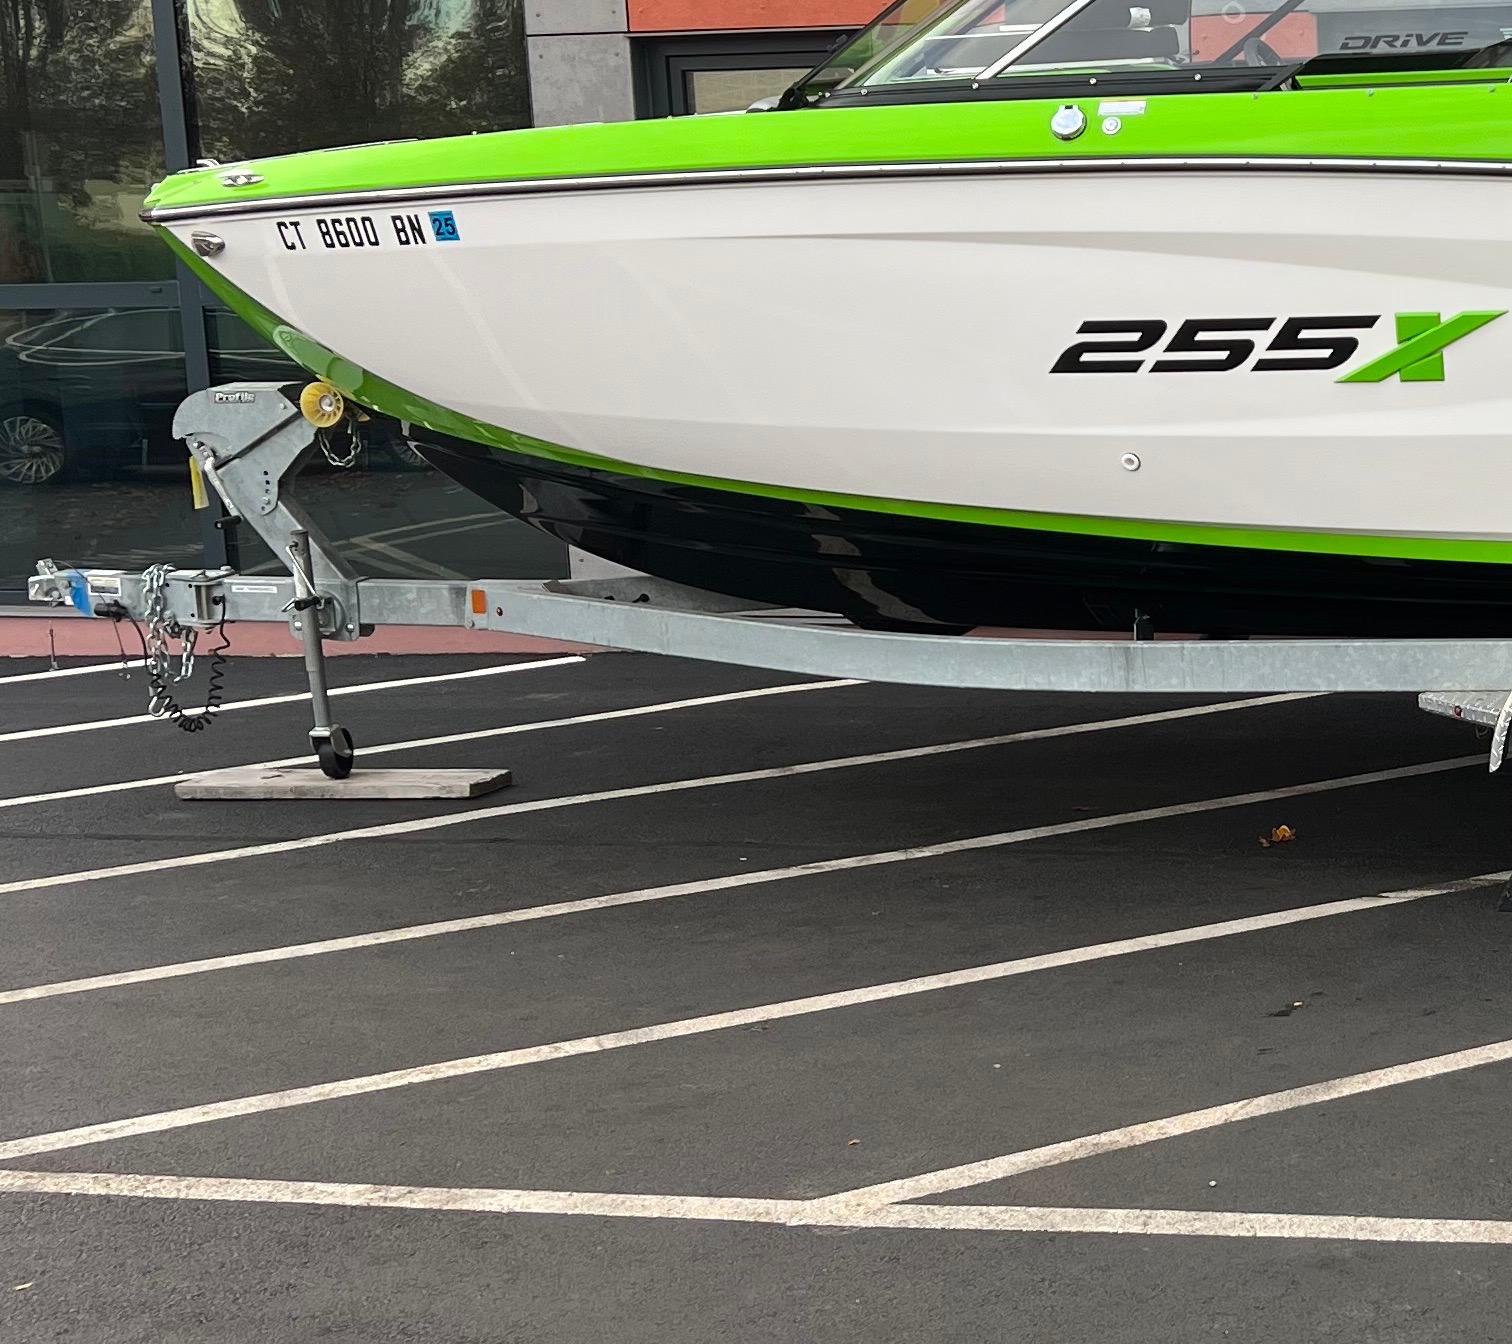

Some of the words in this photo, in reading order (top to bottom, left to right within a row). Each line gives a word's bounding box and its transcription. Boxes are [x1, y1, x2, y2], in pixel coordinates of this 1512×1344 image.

[276, 221, 306, 250] CT
[316, 216, 380, 249] 8600
[391, 214, 427, 246] BN
[432, 217, 456, 236] 25
